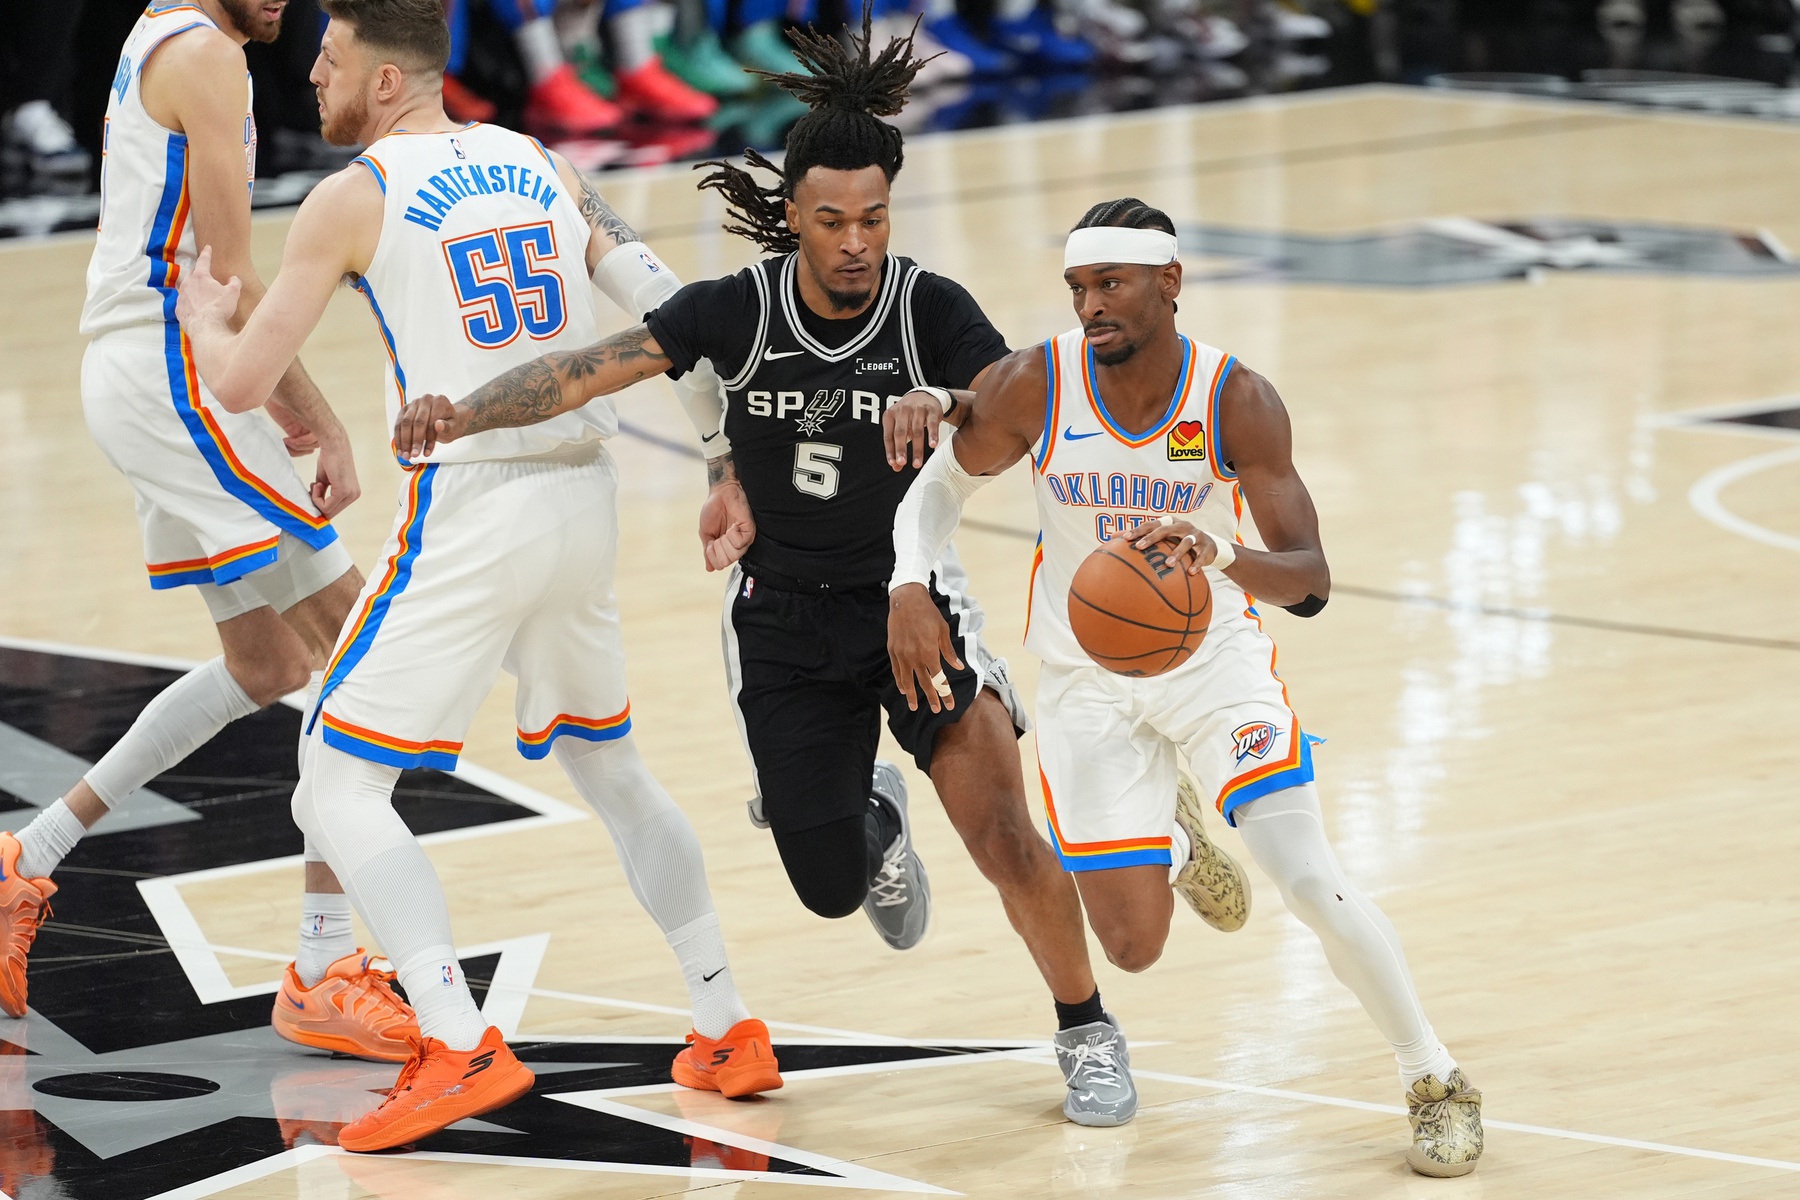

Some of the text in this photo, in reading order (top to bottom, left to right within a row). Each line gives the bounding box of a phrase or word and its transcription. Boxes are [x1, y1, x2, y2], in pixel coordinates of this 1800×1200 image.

[404, 164, 558, 232] HARTENSTEIN
[441, 220, 568, 350] 55
[861, 362, 894, 371] LEDGER
[747, 388, 904, 437] SPUR
[792, 441, 844, 500] 5
[1046, 472, 1214, 513] OKLAHOMA
[1095, 513, 1164, 545] CIT
[1236, 726, 1268, 760] OKC
